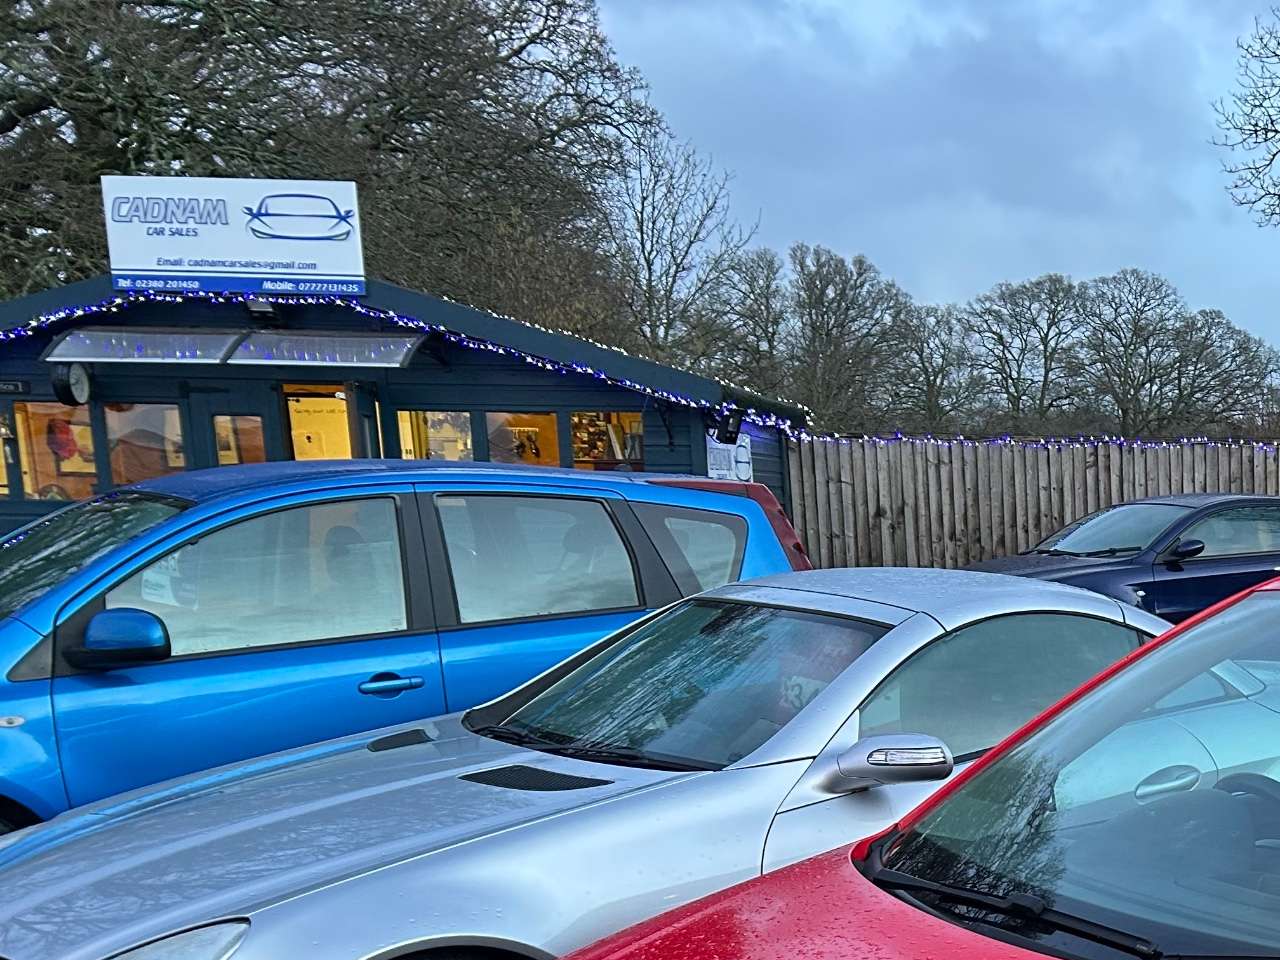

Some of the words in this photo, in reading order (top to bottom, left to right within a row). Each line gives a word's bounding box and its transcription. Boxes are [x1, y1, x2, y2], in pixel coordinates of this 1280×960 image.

[111, 196, 229, 226] CADNAM
[146, 226, 165, 236] CAR
[167, 227, 199, 237] SALES
[157, 257, 185, 267] Email:
[117, 279, 133, 288] Tel:
[262, 280, 296, 291] Mobile:
